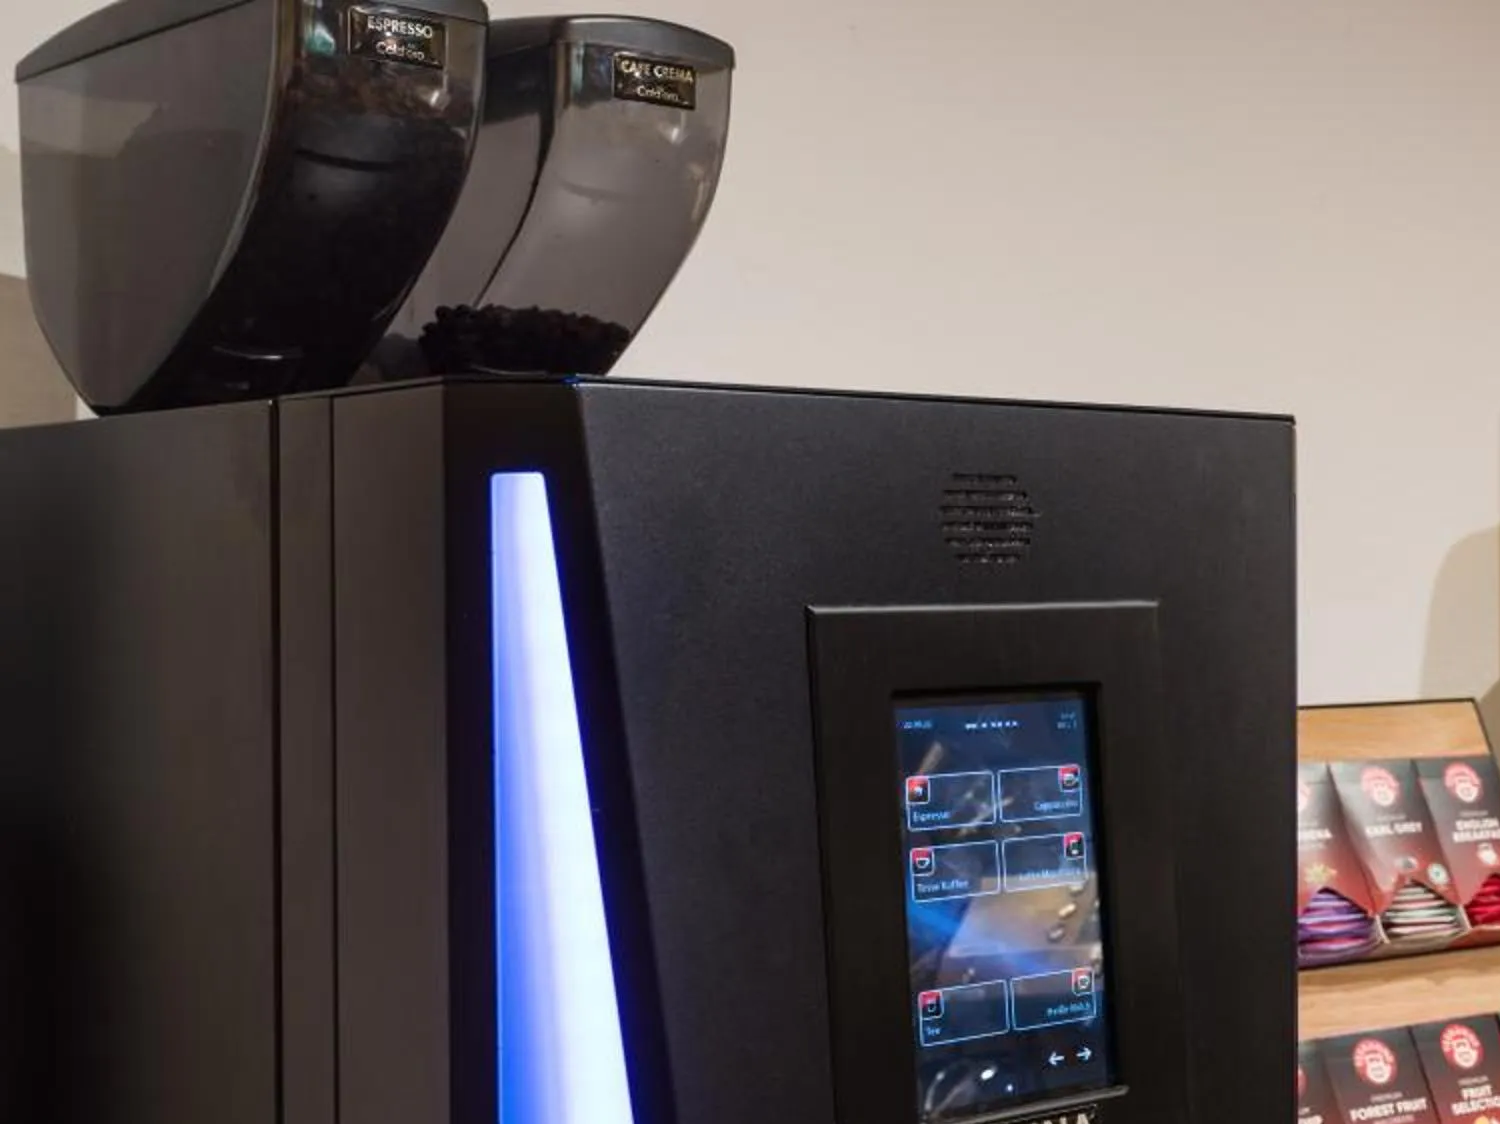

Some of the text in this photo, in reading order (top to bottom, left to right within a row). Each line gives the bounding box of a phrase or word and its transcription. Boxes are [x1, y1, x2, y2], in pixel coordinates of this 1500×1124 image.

[367, 15, 433, 39] ESPRESSO
[1461, 1084, 1493, 1101] FRUIT
[1350, 1098, 1427, 1121] FOREST FRUIT
